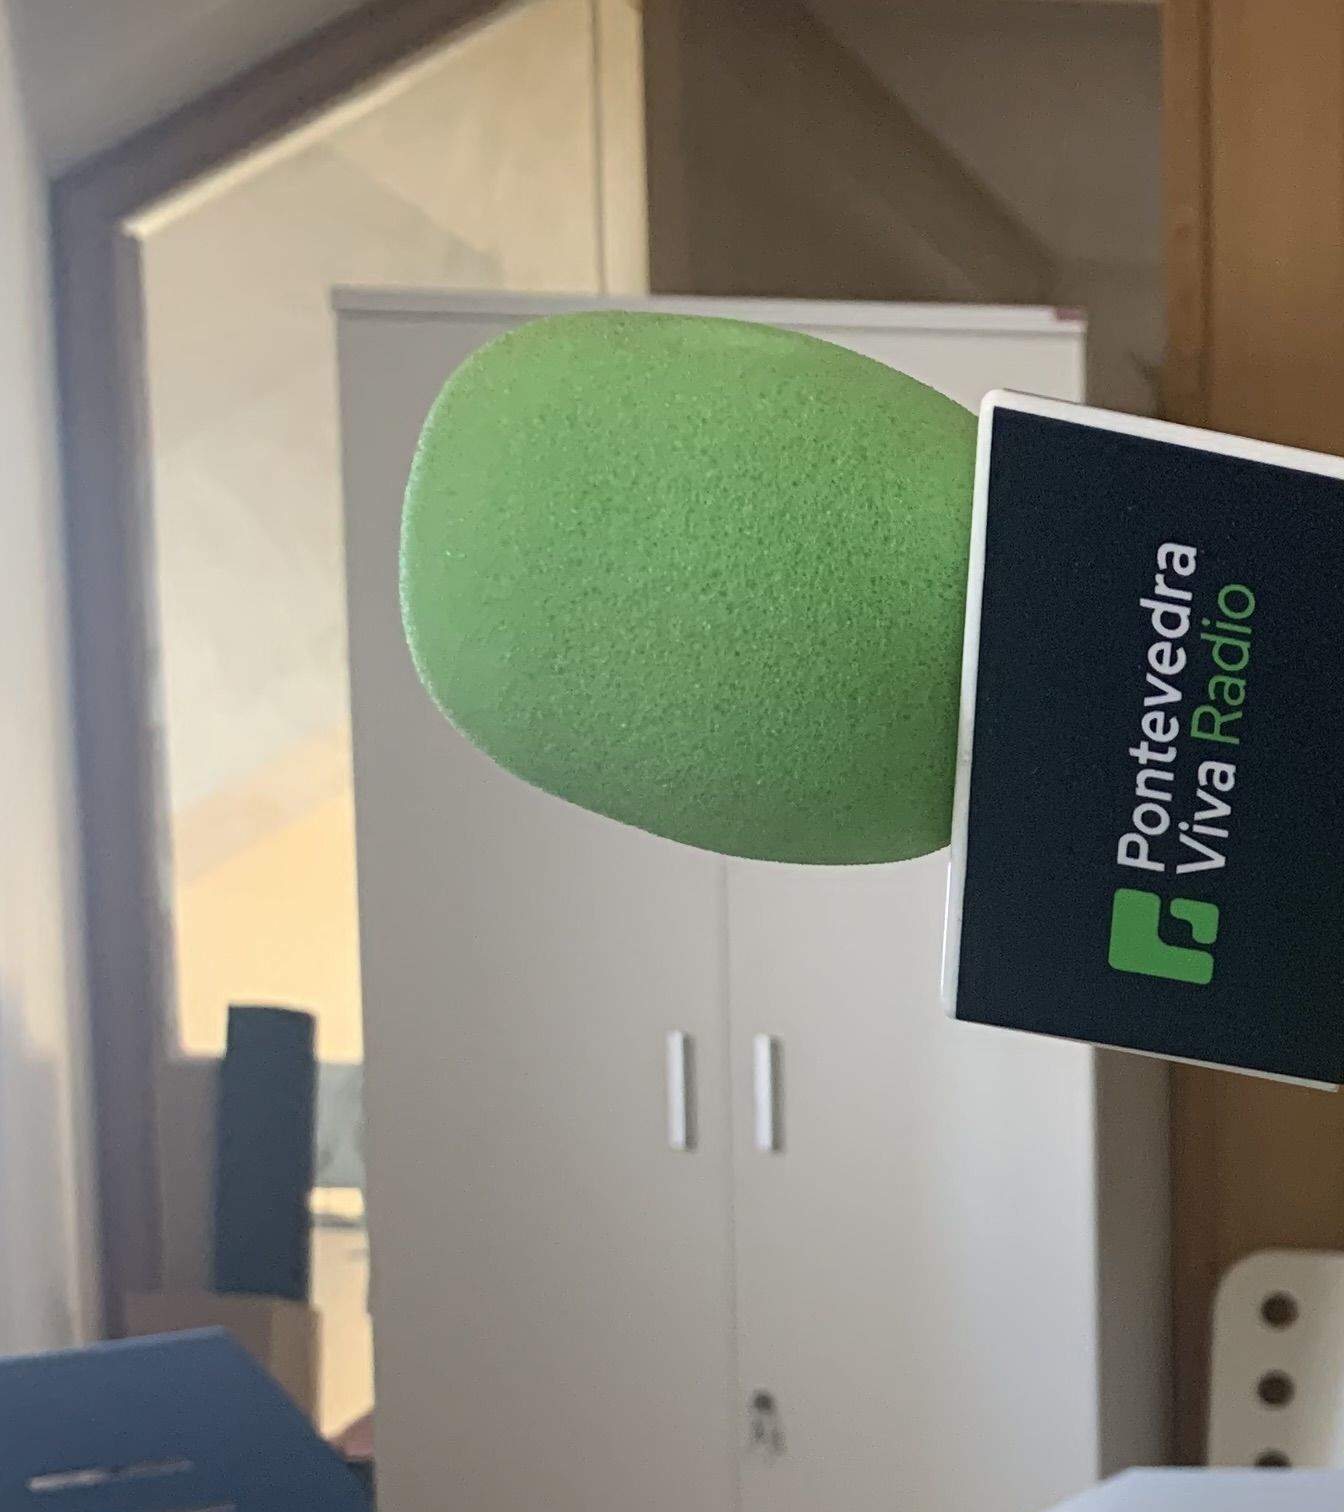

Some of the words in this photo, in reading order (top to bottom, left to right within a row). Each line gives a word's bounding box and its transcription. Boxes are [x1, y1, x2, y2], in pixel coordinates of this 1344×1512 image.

[1117, 541, 1198, 873] Pontevedra
[1191, 583, 1256, 745] Radio
[1176, 759, 1237, 875] Viva
